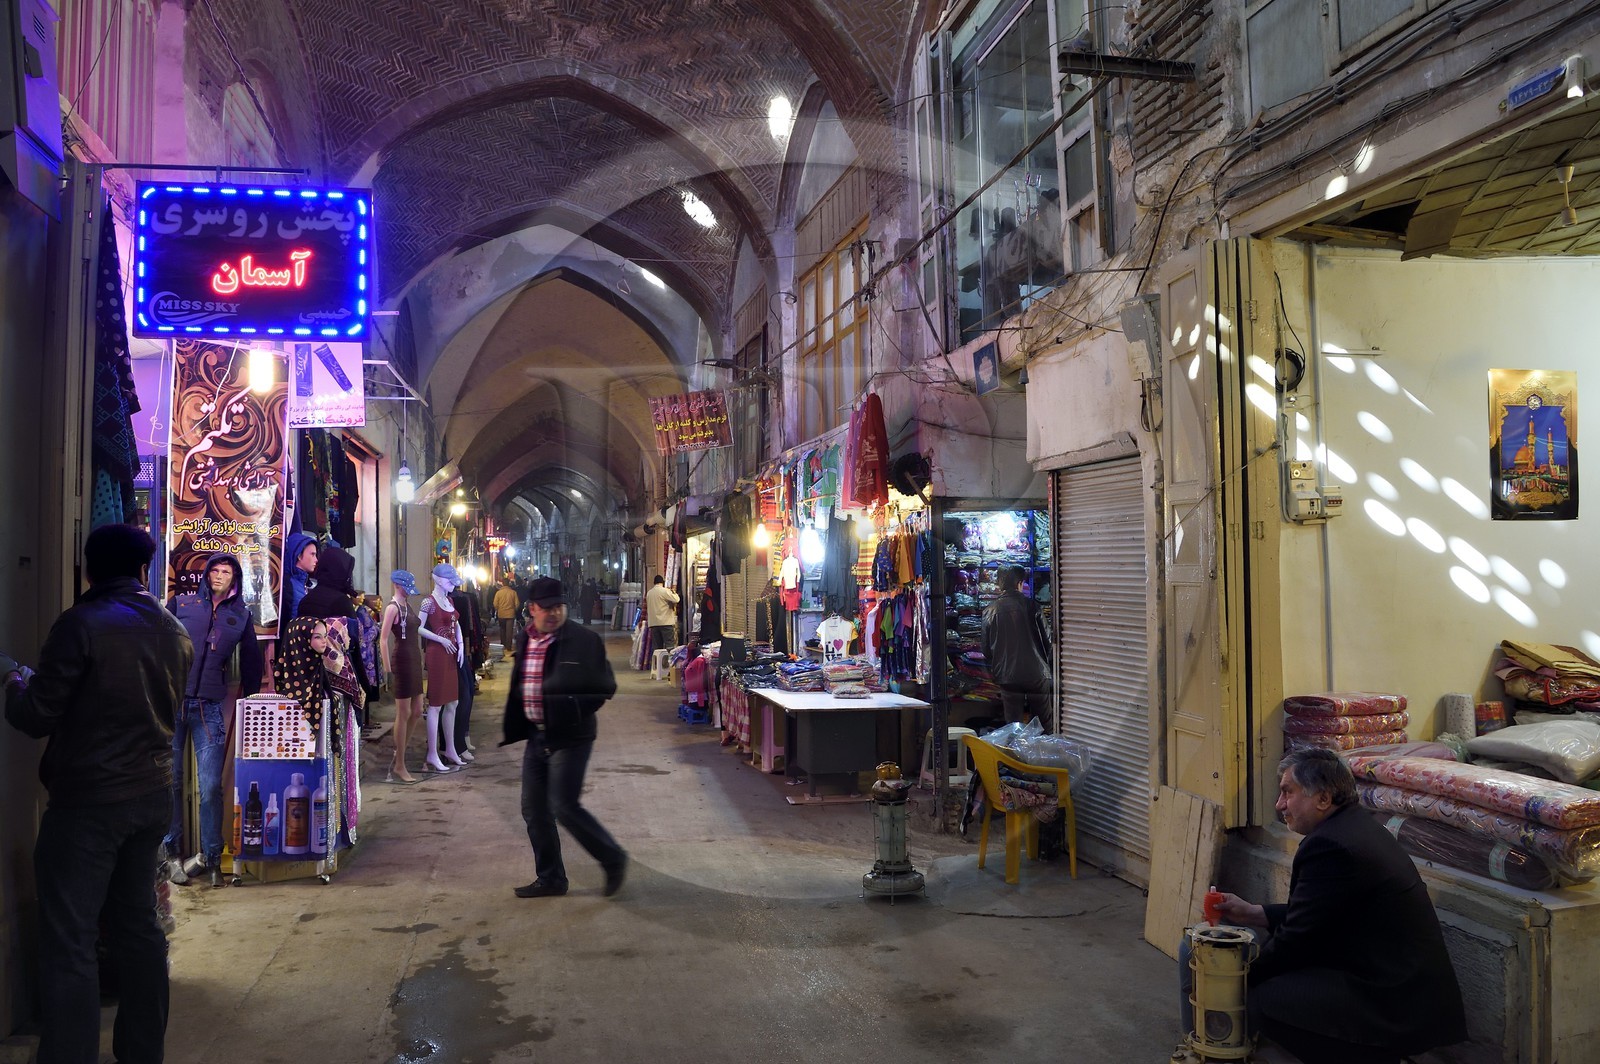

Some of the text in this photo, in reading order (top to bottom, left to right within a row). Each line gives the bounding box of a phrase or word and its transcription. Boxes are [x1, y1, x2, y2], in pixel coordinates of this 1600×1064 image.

[152, 200, 356, 246] پخش روسری
[212, 248, 312, 295] آسمان
[159, 300, 241, 313] MISS SKY
[317, 413, 364, 426] فروشگاه
[231, 476, 239, 487] و
[172, 518, 211, 535] آرایشی
[210, 520, 237, 535] لوازم
[237, 523, 256, 534] کننده
[193, 539, 260, 554] عروس و داماد
